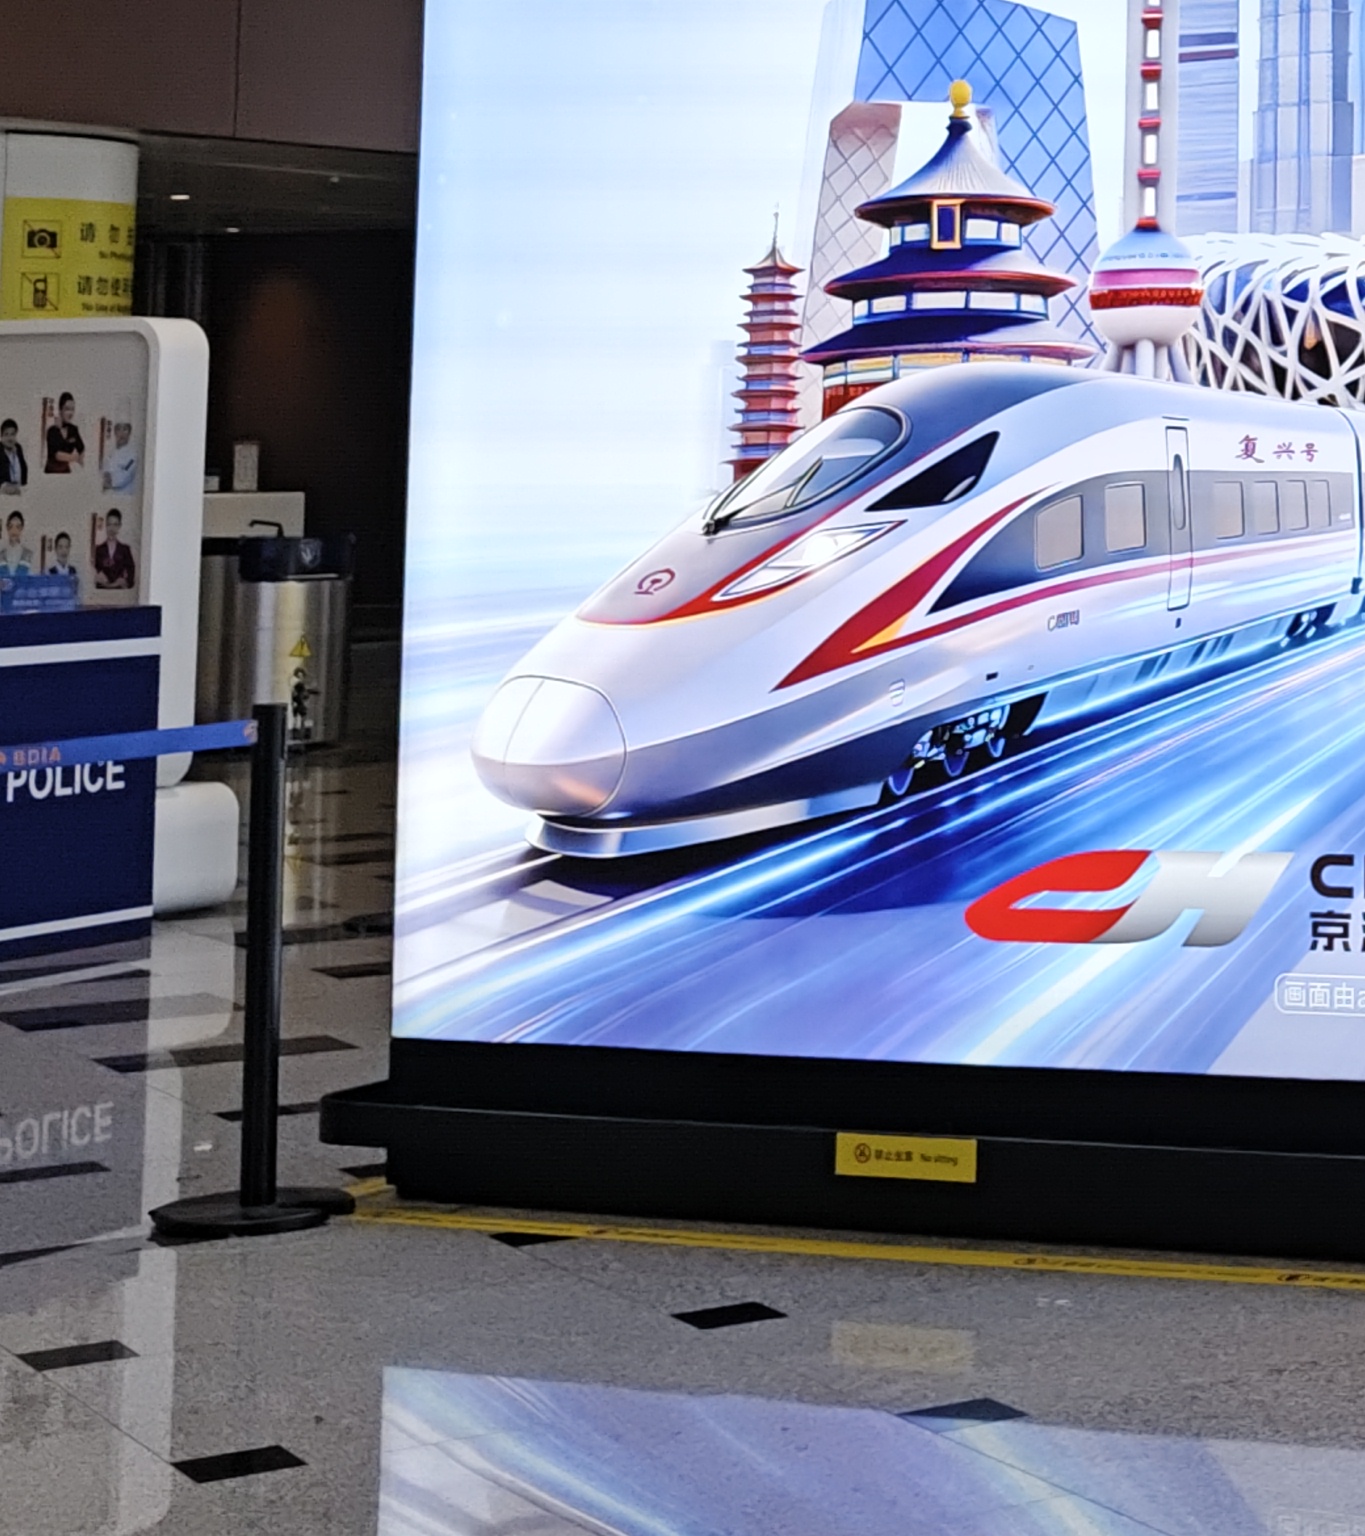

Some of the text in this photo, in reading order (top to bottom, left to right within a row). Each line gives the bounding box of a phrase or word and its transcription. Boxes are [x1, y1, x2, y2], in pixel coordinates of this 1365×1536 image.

[1235, 434, 1319, 464] 复兴号
[6, 760, 125, 803] POLICE
